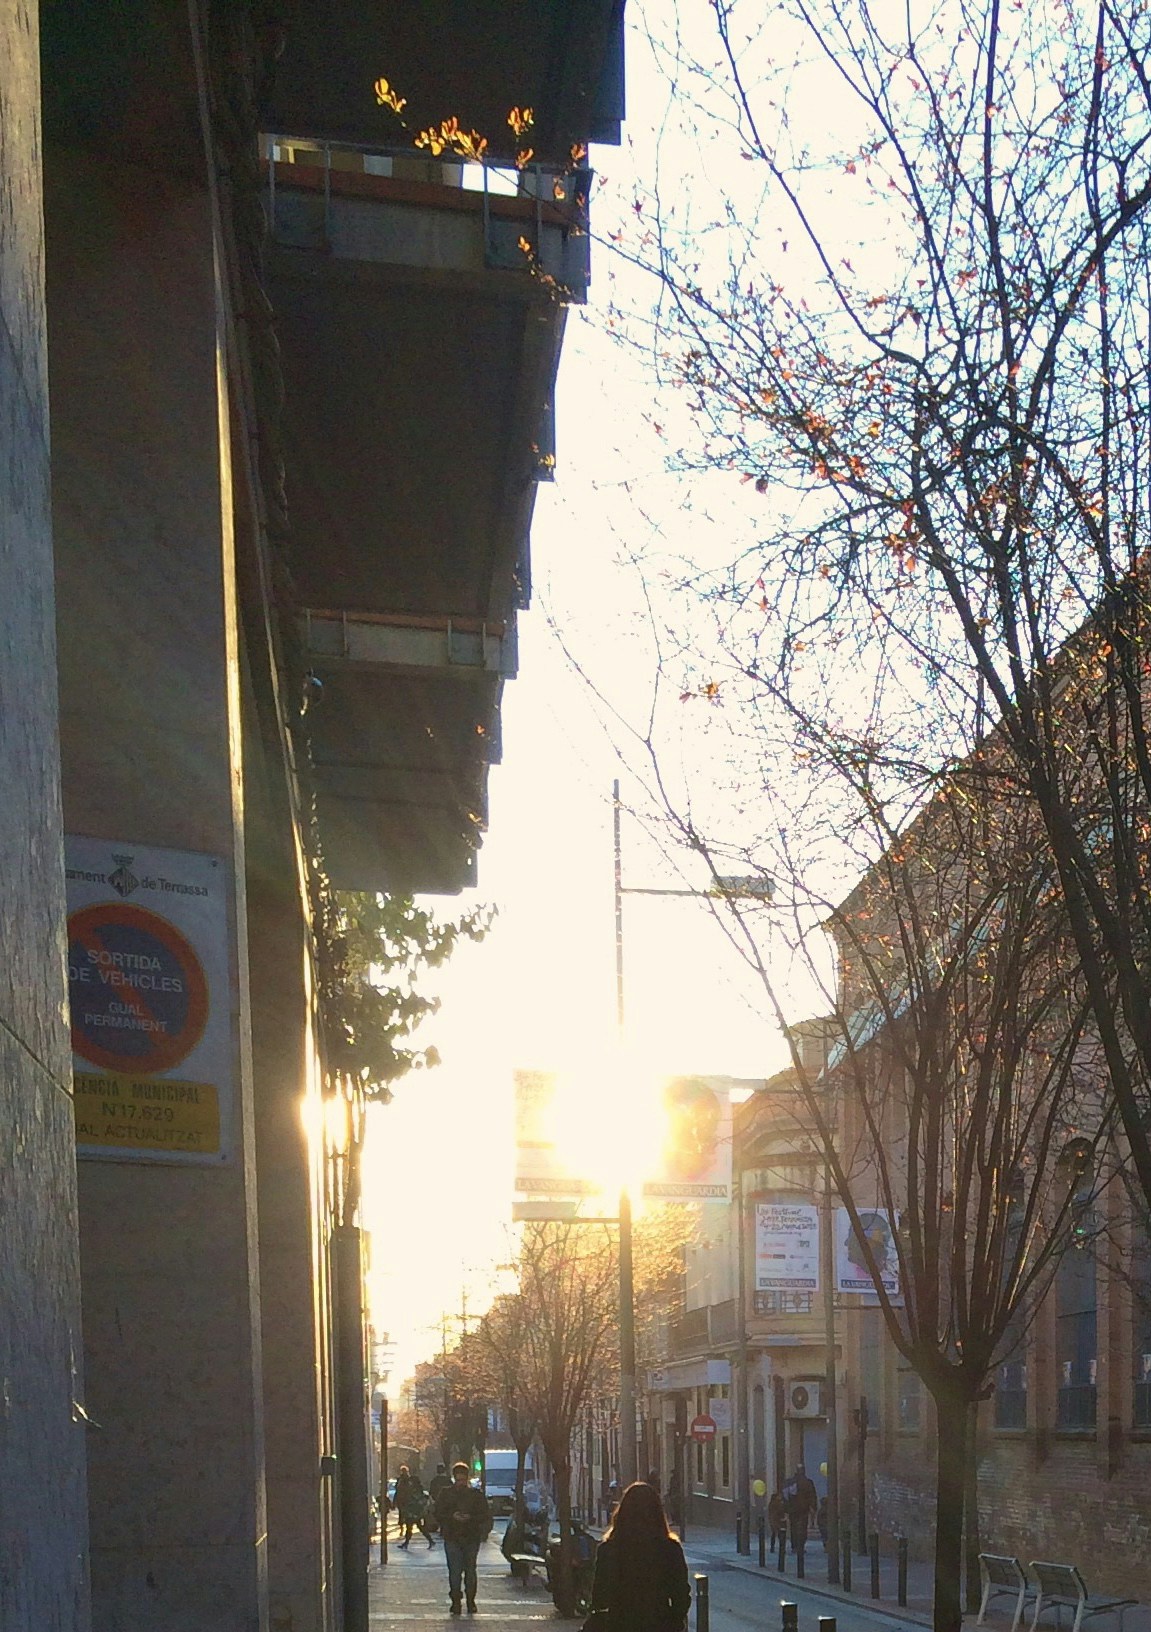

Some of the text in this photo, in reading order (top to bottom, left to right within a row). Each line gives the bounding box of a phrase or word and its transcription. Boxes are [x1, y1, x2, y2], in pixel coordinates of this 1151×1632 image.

[66, 869, 208, 896] ament de Terrassa
[87, 950, 162, 971] SORTIDA
[69, 967, 183, 993] DE VEHICLES
[109, 1002, 145, 1017] GUAL
[84, 1013, 167, 1033] PERMANENT
[132, 1083, 200, 1104] MUNICIPAL
[660, 1184, 727, 1198] VANGUARDIA
